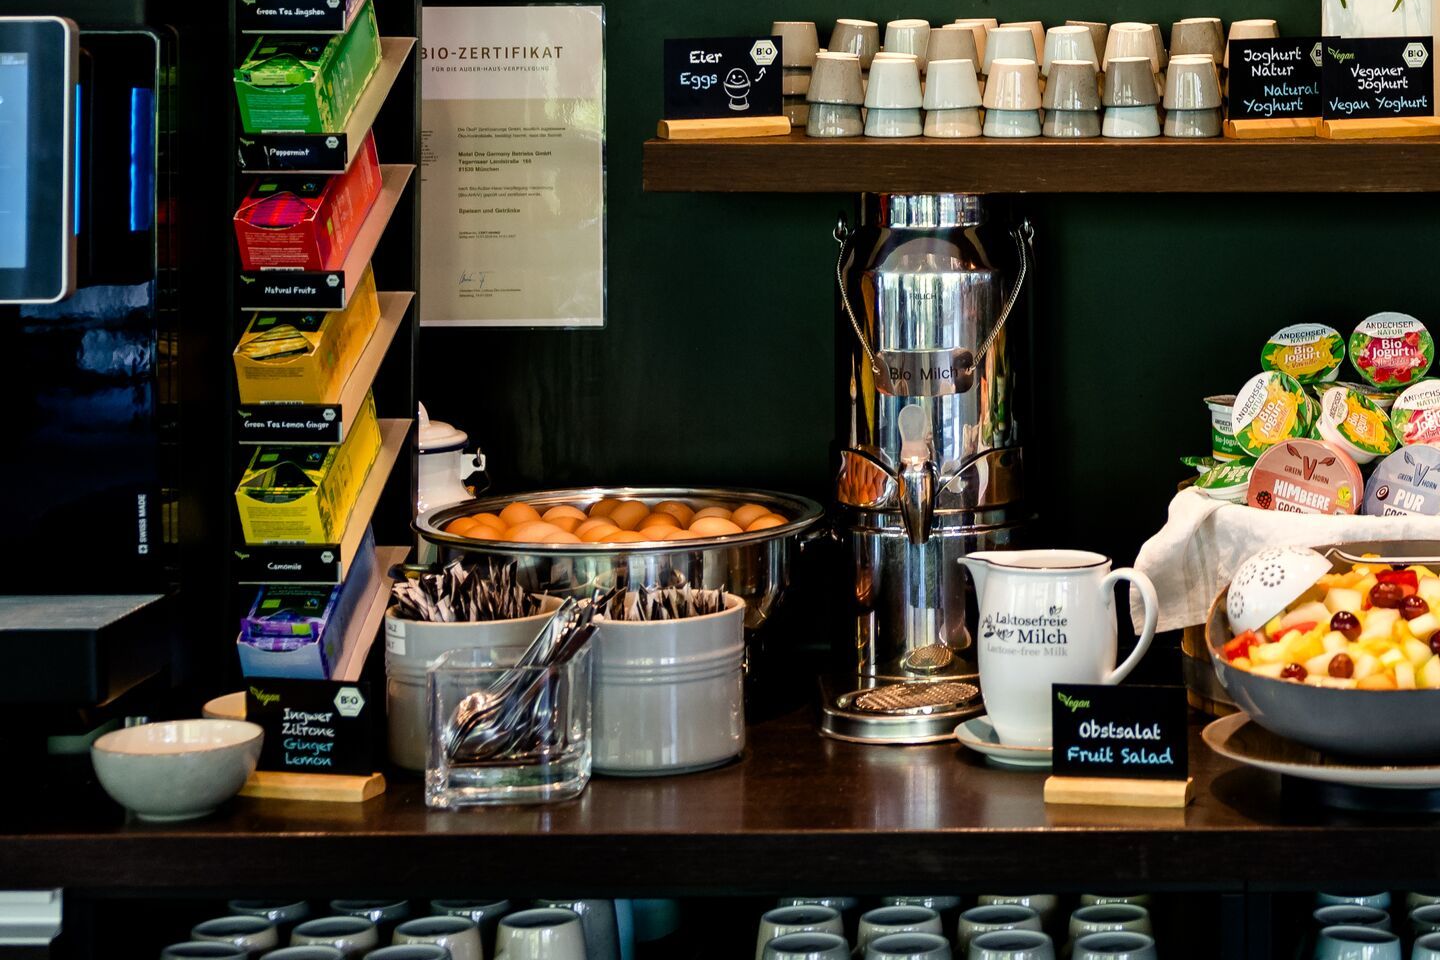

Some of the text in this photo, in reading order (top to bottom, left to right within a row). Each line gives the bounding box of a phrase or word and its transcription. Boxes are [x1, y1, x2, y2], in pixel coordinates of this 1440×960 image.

[421, 46, 563, 60] BIO-ZERTIFIKAT
[689, 50, 722, 64] Eier
[1243, 47, 1302, 63] Joghurt
[1251, 64, 1294, 77] Natur
[1350, 64, 1404, 80] Veganer
[680, 72, 718, 90] Eggs
[1358, 78, 1408, 94] Joghurt
[1264, 82, 1319, 97] Natural
[1243, 98, 1303, 117] Yoghurt
[1329, 95, 1428, 114] Vegan Yoghurt
[1366, 320, 1414, 329] ANDECHSER
[1377, 328, 1403, 336] NATUR
[1278, 328, 1327, 340] ANDECHSER
[1294, 345, 1314, 355] Bio
[1381, 339, 1402, 349] Bio
[1284, 351, 1321, 364] Jogurt
[1372, 347, 1410, 360] Jogurt
[889, 366, 958, 381] Bio Milch
[1235, 378, 1265, 424] ANDECHSER
[1273, 479, 1331, 511] HIMBEERE
[1393, 488, 1425, 512] PUR
[996, 611, 1068, 627] Laktosefreie
[1017, 628, 1068, 644] Milch
[987, 644, 1068, 657] Lactose-free Milk
[1060, 693, 1090, 712] Vegan
[283, 707, 333, 726] Ingwer
[281, 723, 335, 737] Zitrone
[1079, 719, 1161, 740] Obstsalat
[283, 738, 334, 755] Ginger
[285, 752, 332, 766] Lemon
[1067, 746, 1174, 765] Fruit Salad
